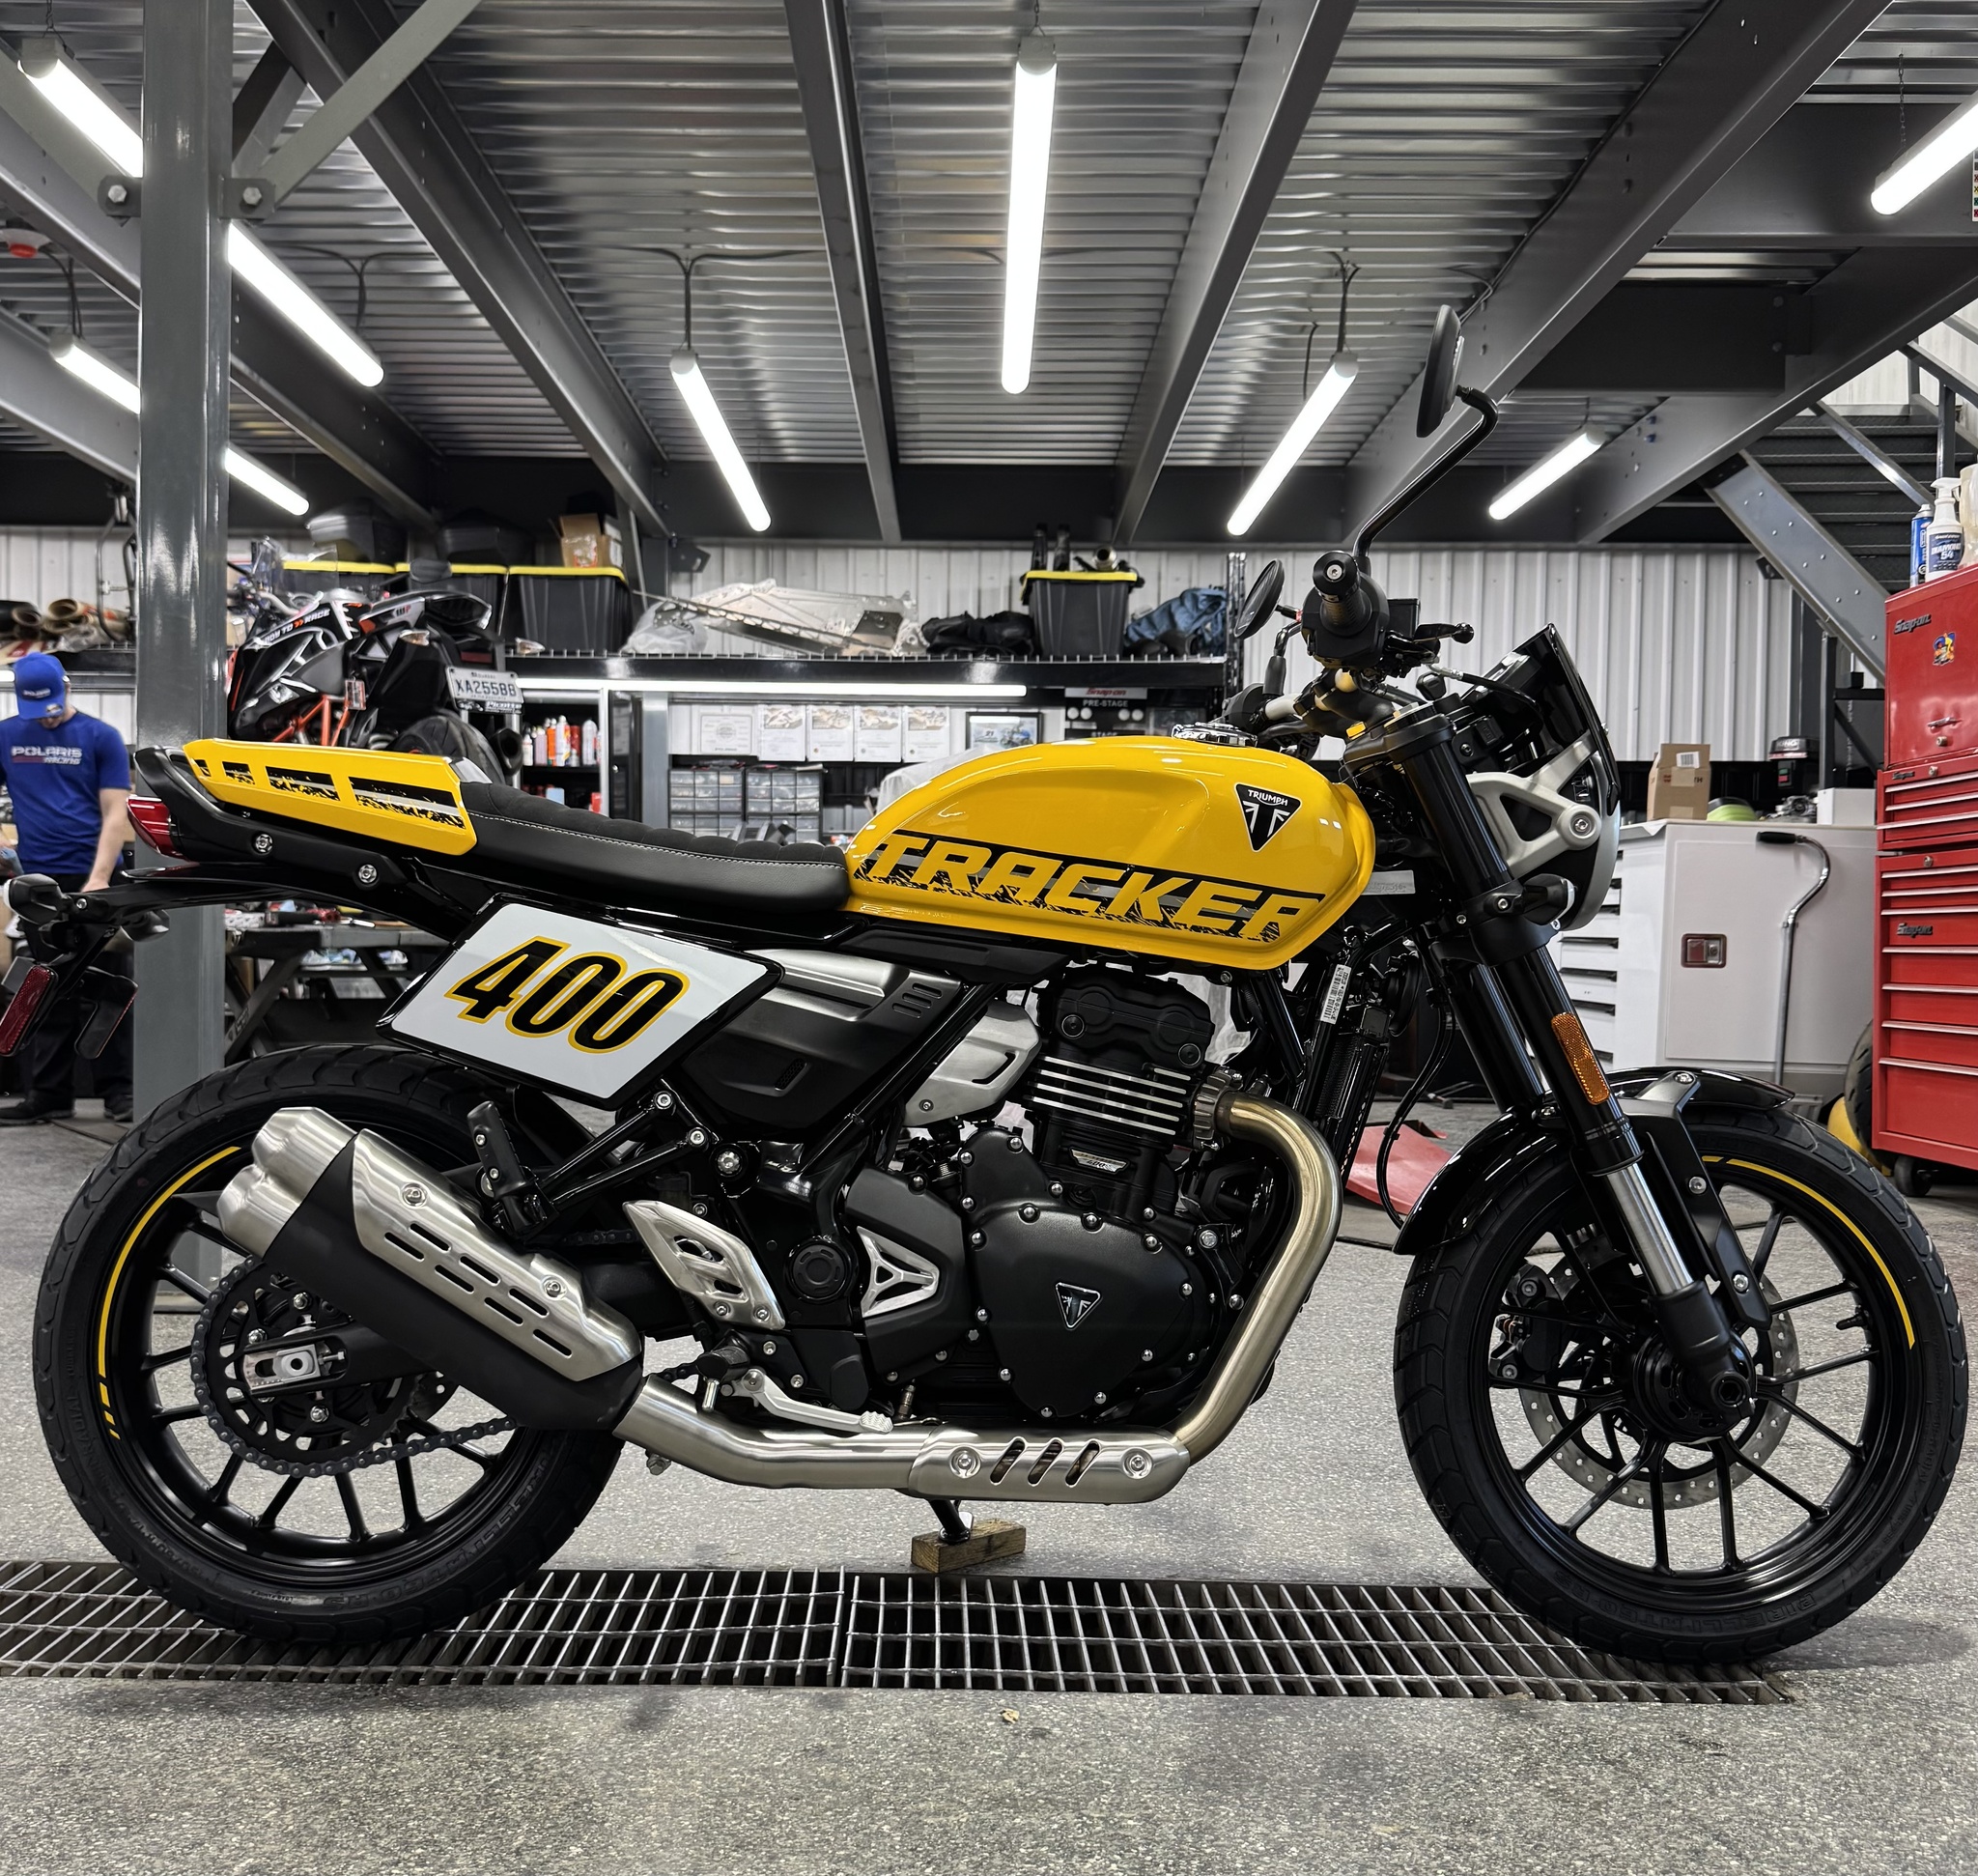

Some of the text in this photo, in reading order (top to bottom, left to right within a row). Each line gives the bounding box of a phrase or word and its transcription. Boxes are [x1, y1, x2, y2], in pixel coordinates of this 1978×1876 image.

[1083, 698, 1128, 708] PRE-STAGE
[12, 745, 82, 758] POLARIS
[1248, 789, 1288, 807] TRIUMPH
[867, 833, 1320, 940] TRACKER
[444, 935, 690, 1054] 400
